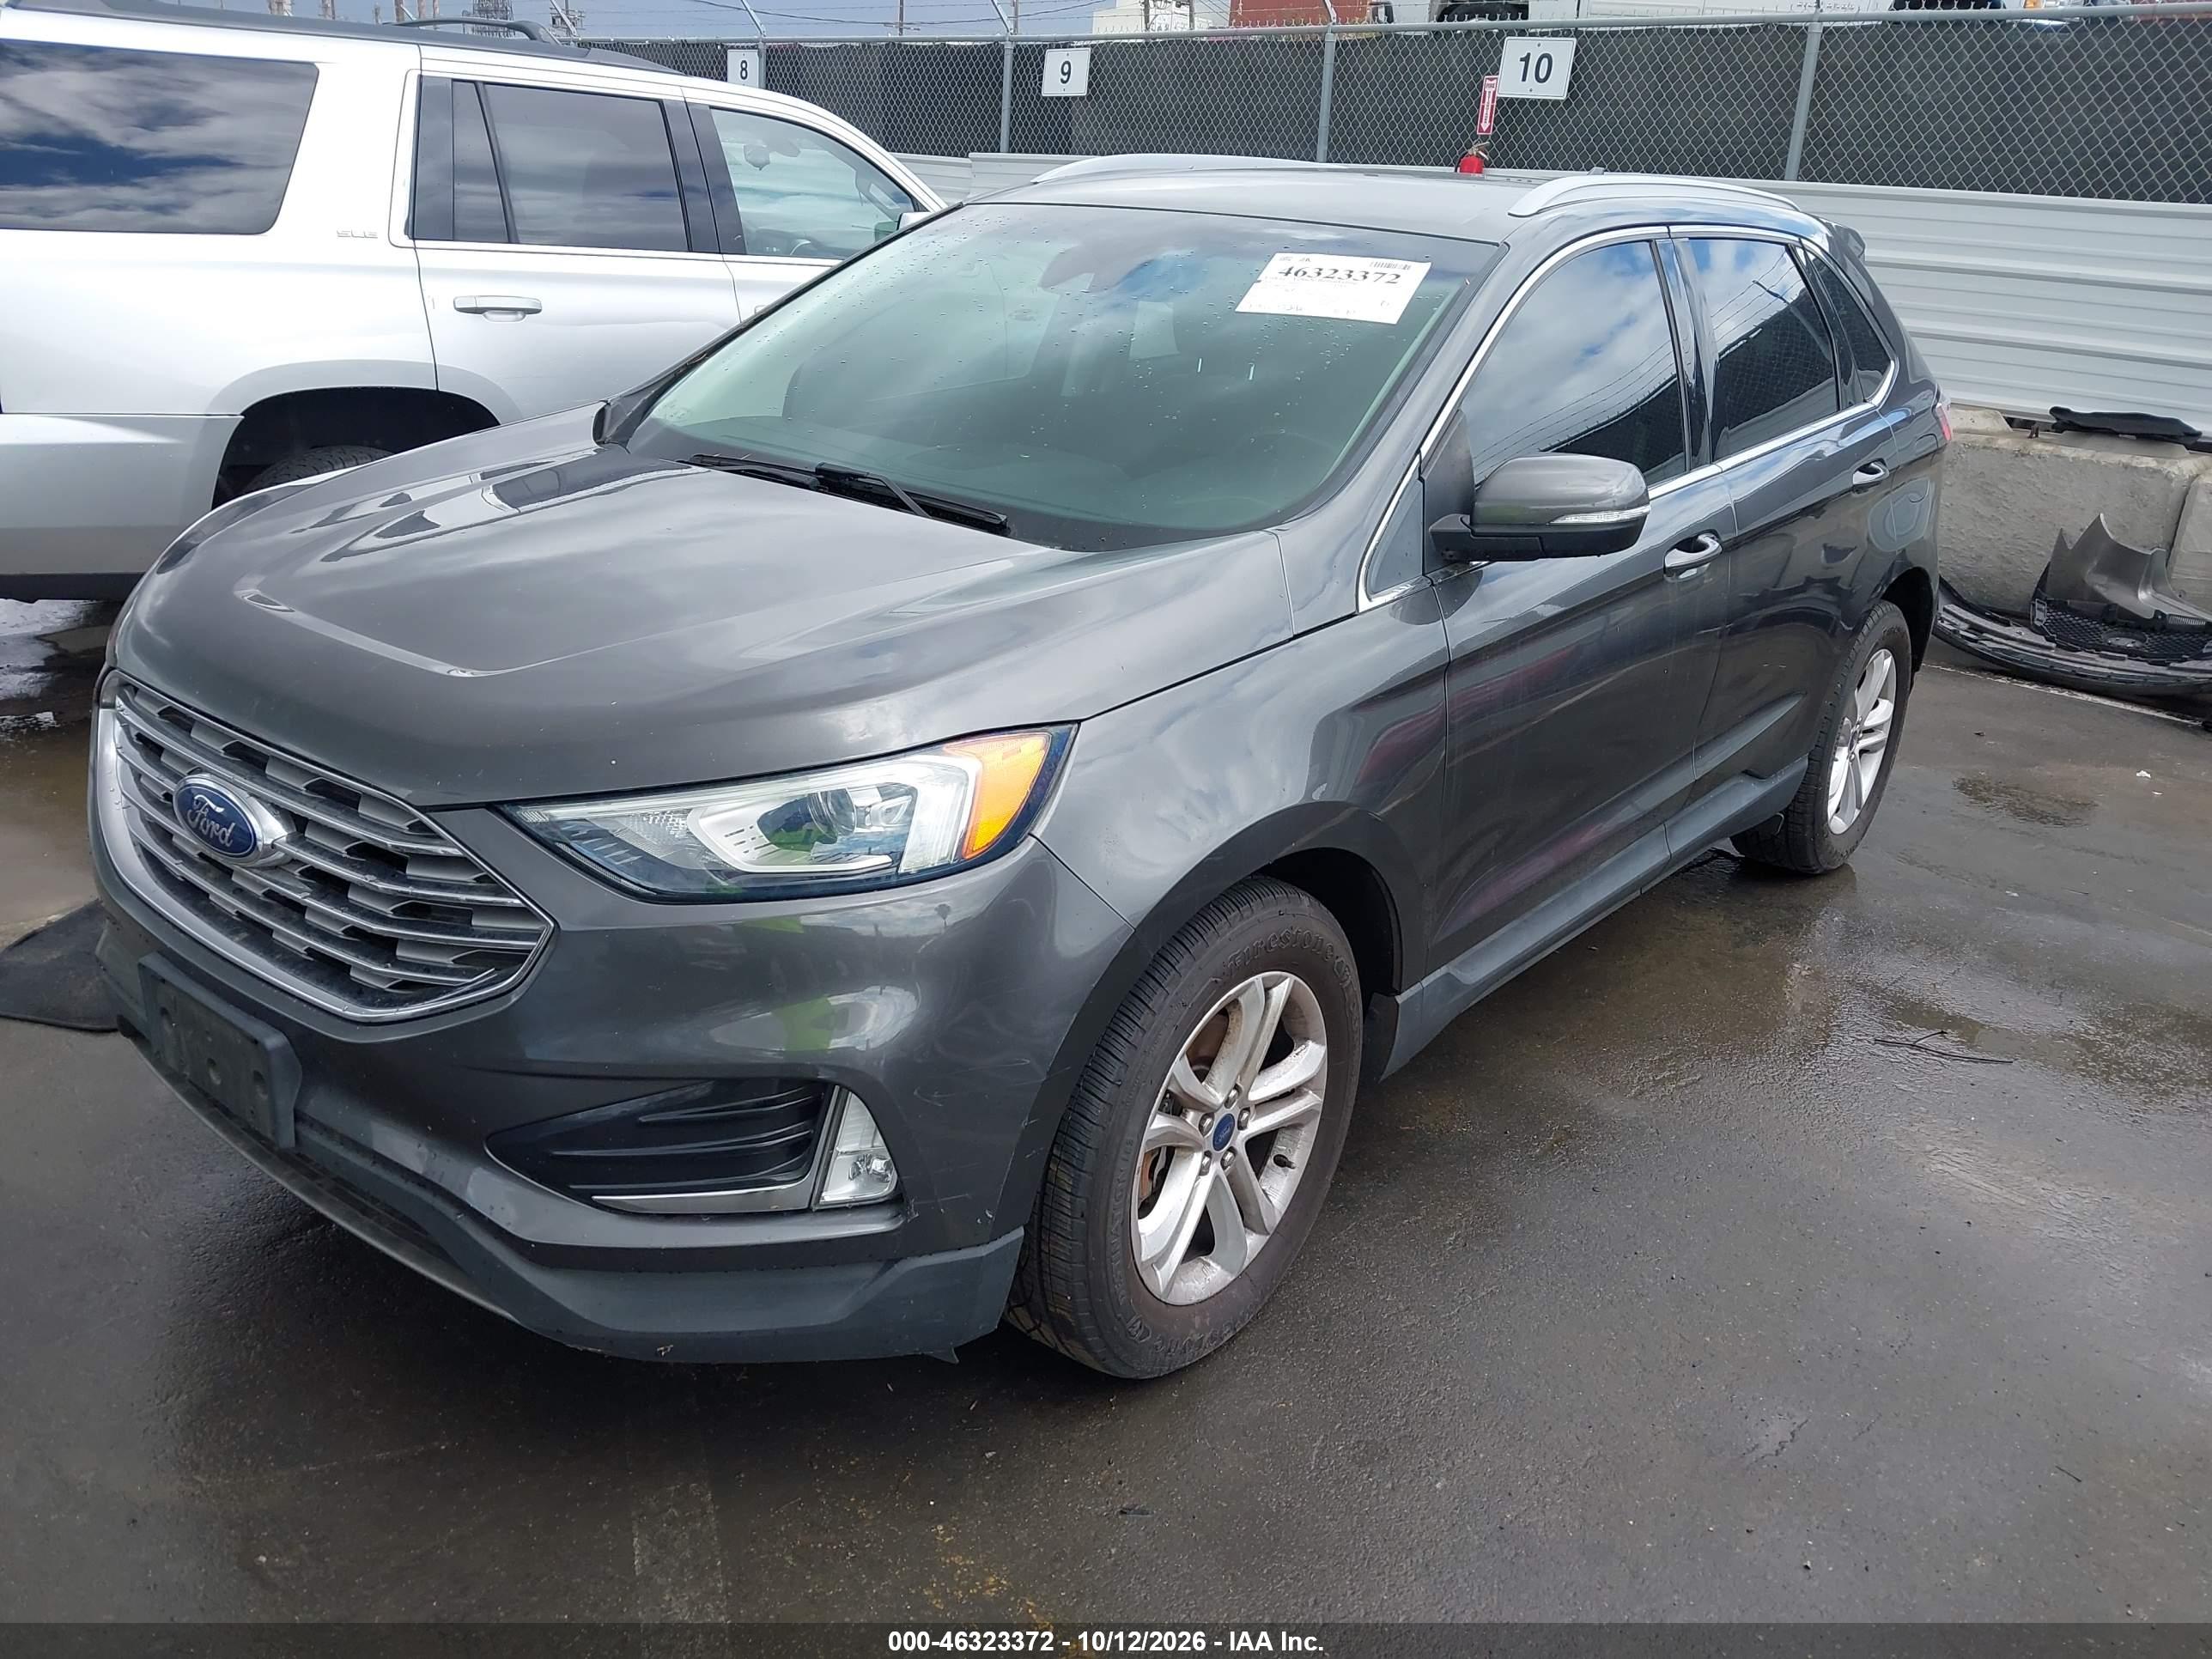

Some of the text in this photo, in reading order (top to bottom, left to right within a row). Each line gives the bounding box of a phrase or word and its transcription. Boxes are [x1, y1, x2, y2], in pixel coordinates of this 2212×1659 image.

[739, 59, 748, 80] 8
[1060, 60, 1072, 84] 9
[1519, 52, 1553, 83] 10
[1278, 265, 1401, 284] 46323372
[186, 793, 236, 848] Ford
[1225, 927, 1334, 976] Firestone
